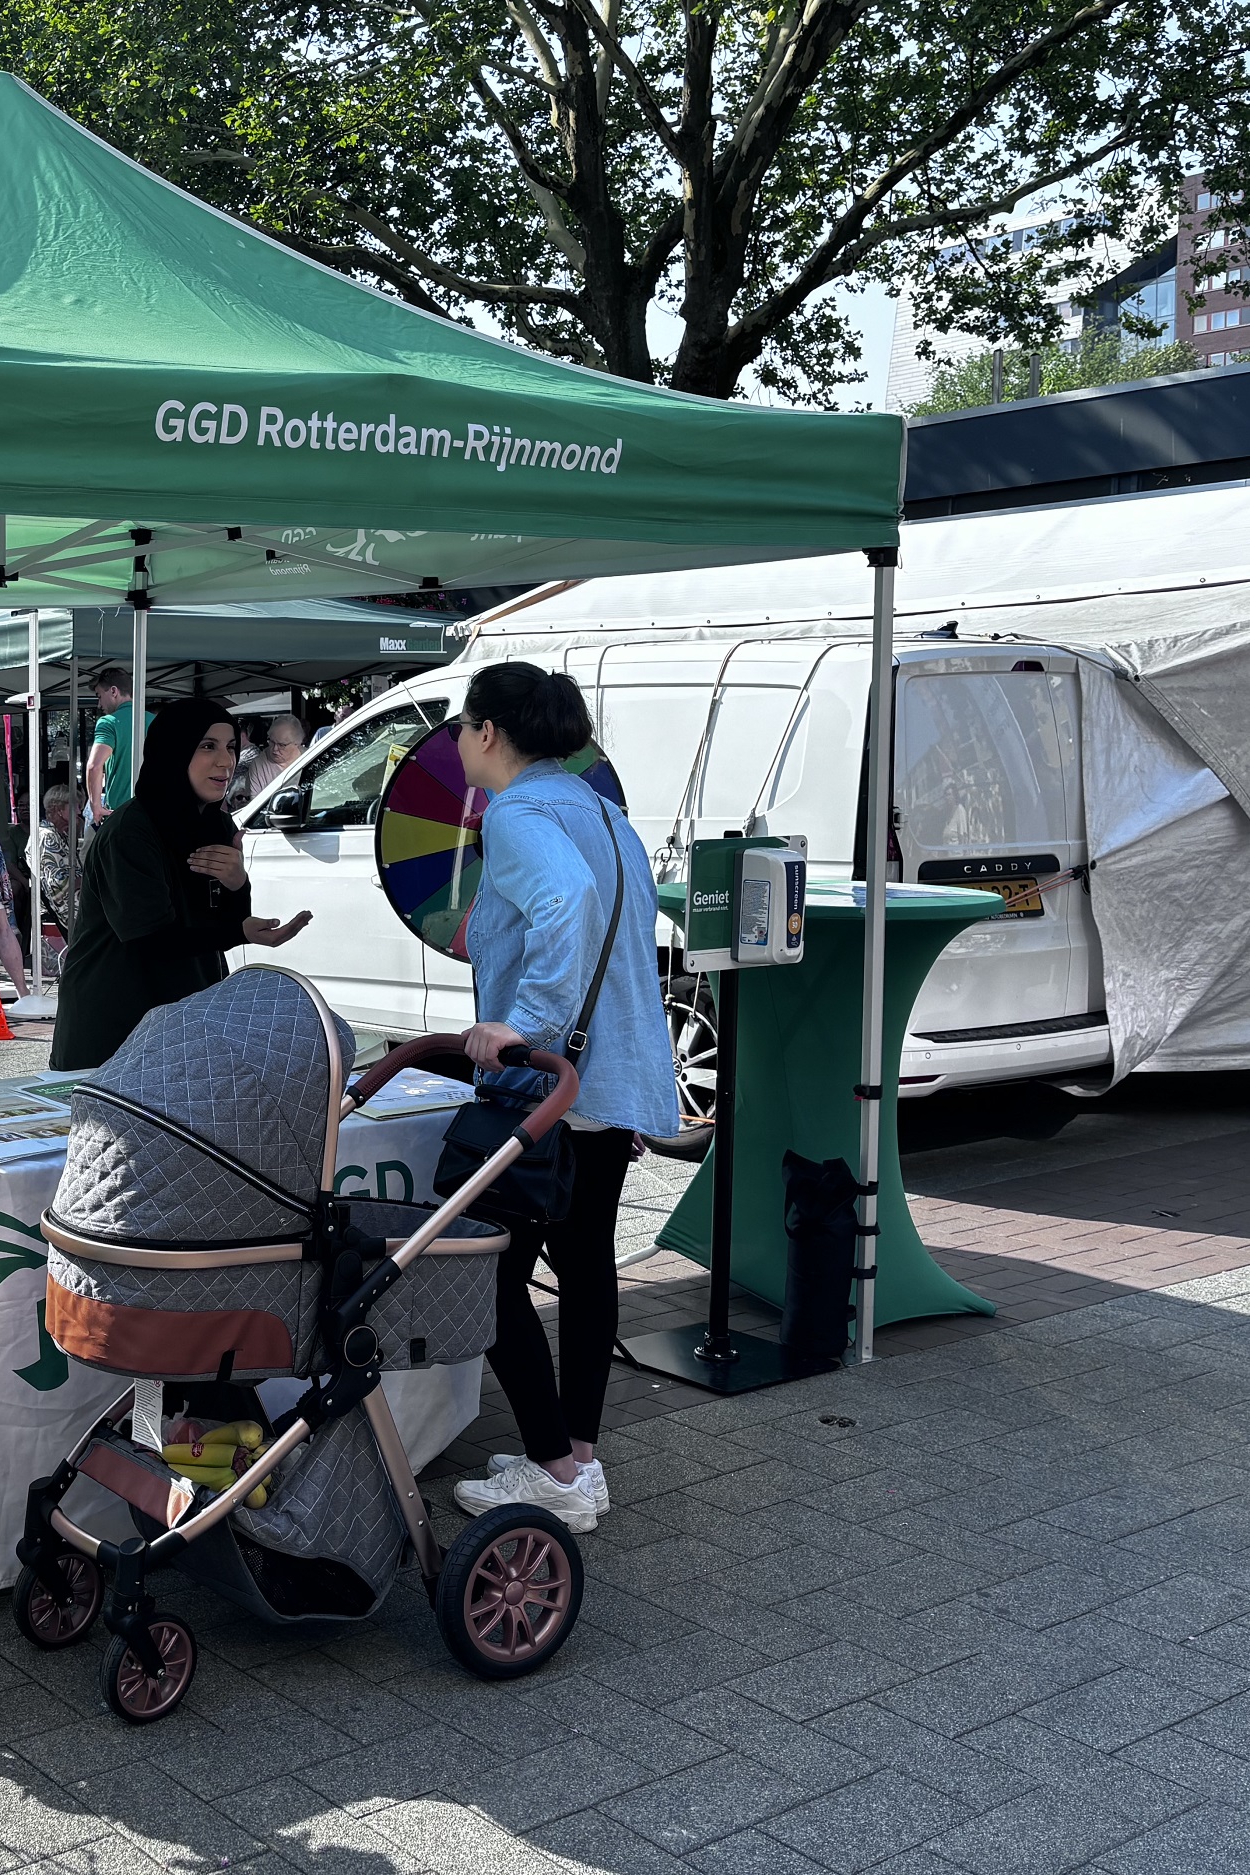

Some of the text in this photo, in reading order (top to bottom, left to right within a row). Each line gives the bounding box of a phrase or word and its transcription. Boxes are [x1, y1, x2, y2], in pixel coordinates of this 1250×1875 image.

[155, 399, 623, 474] GGD Rotterdam-Rijnmond
[380, 637, 406, 650] Maxx
[964, 862, 1032, 874] CADDY
[694, 890, 730, 906] Geniet
[334, 1160, 414, 1202] GD
